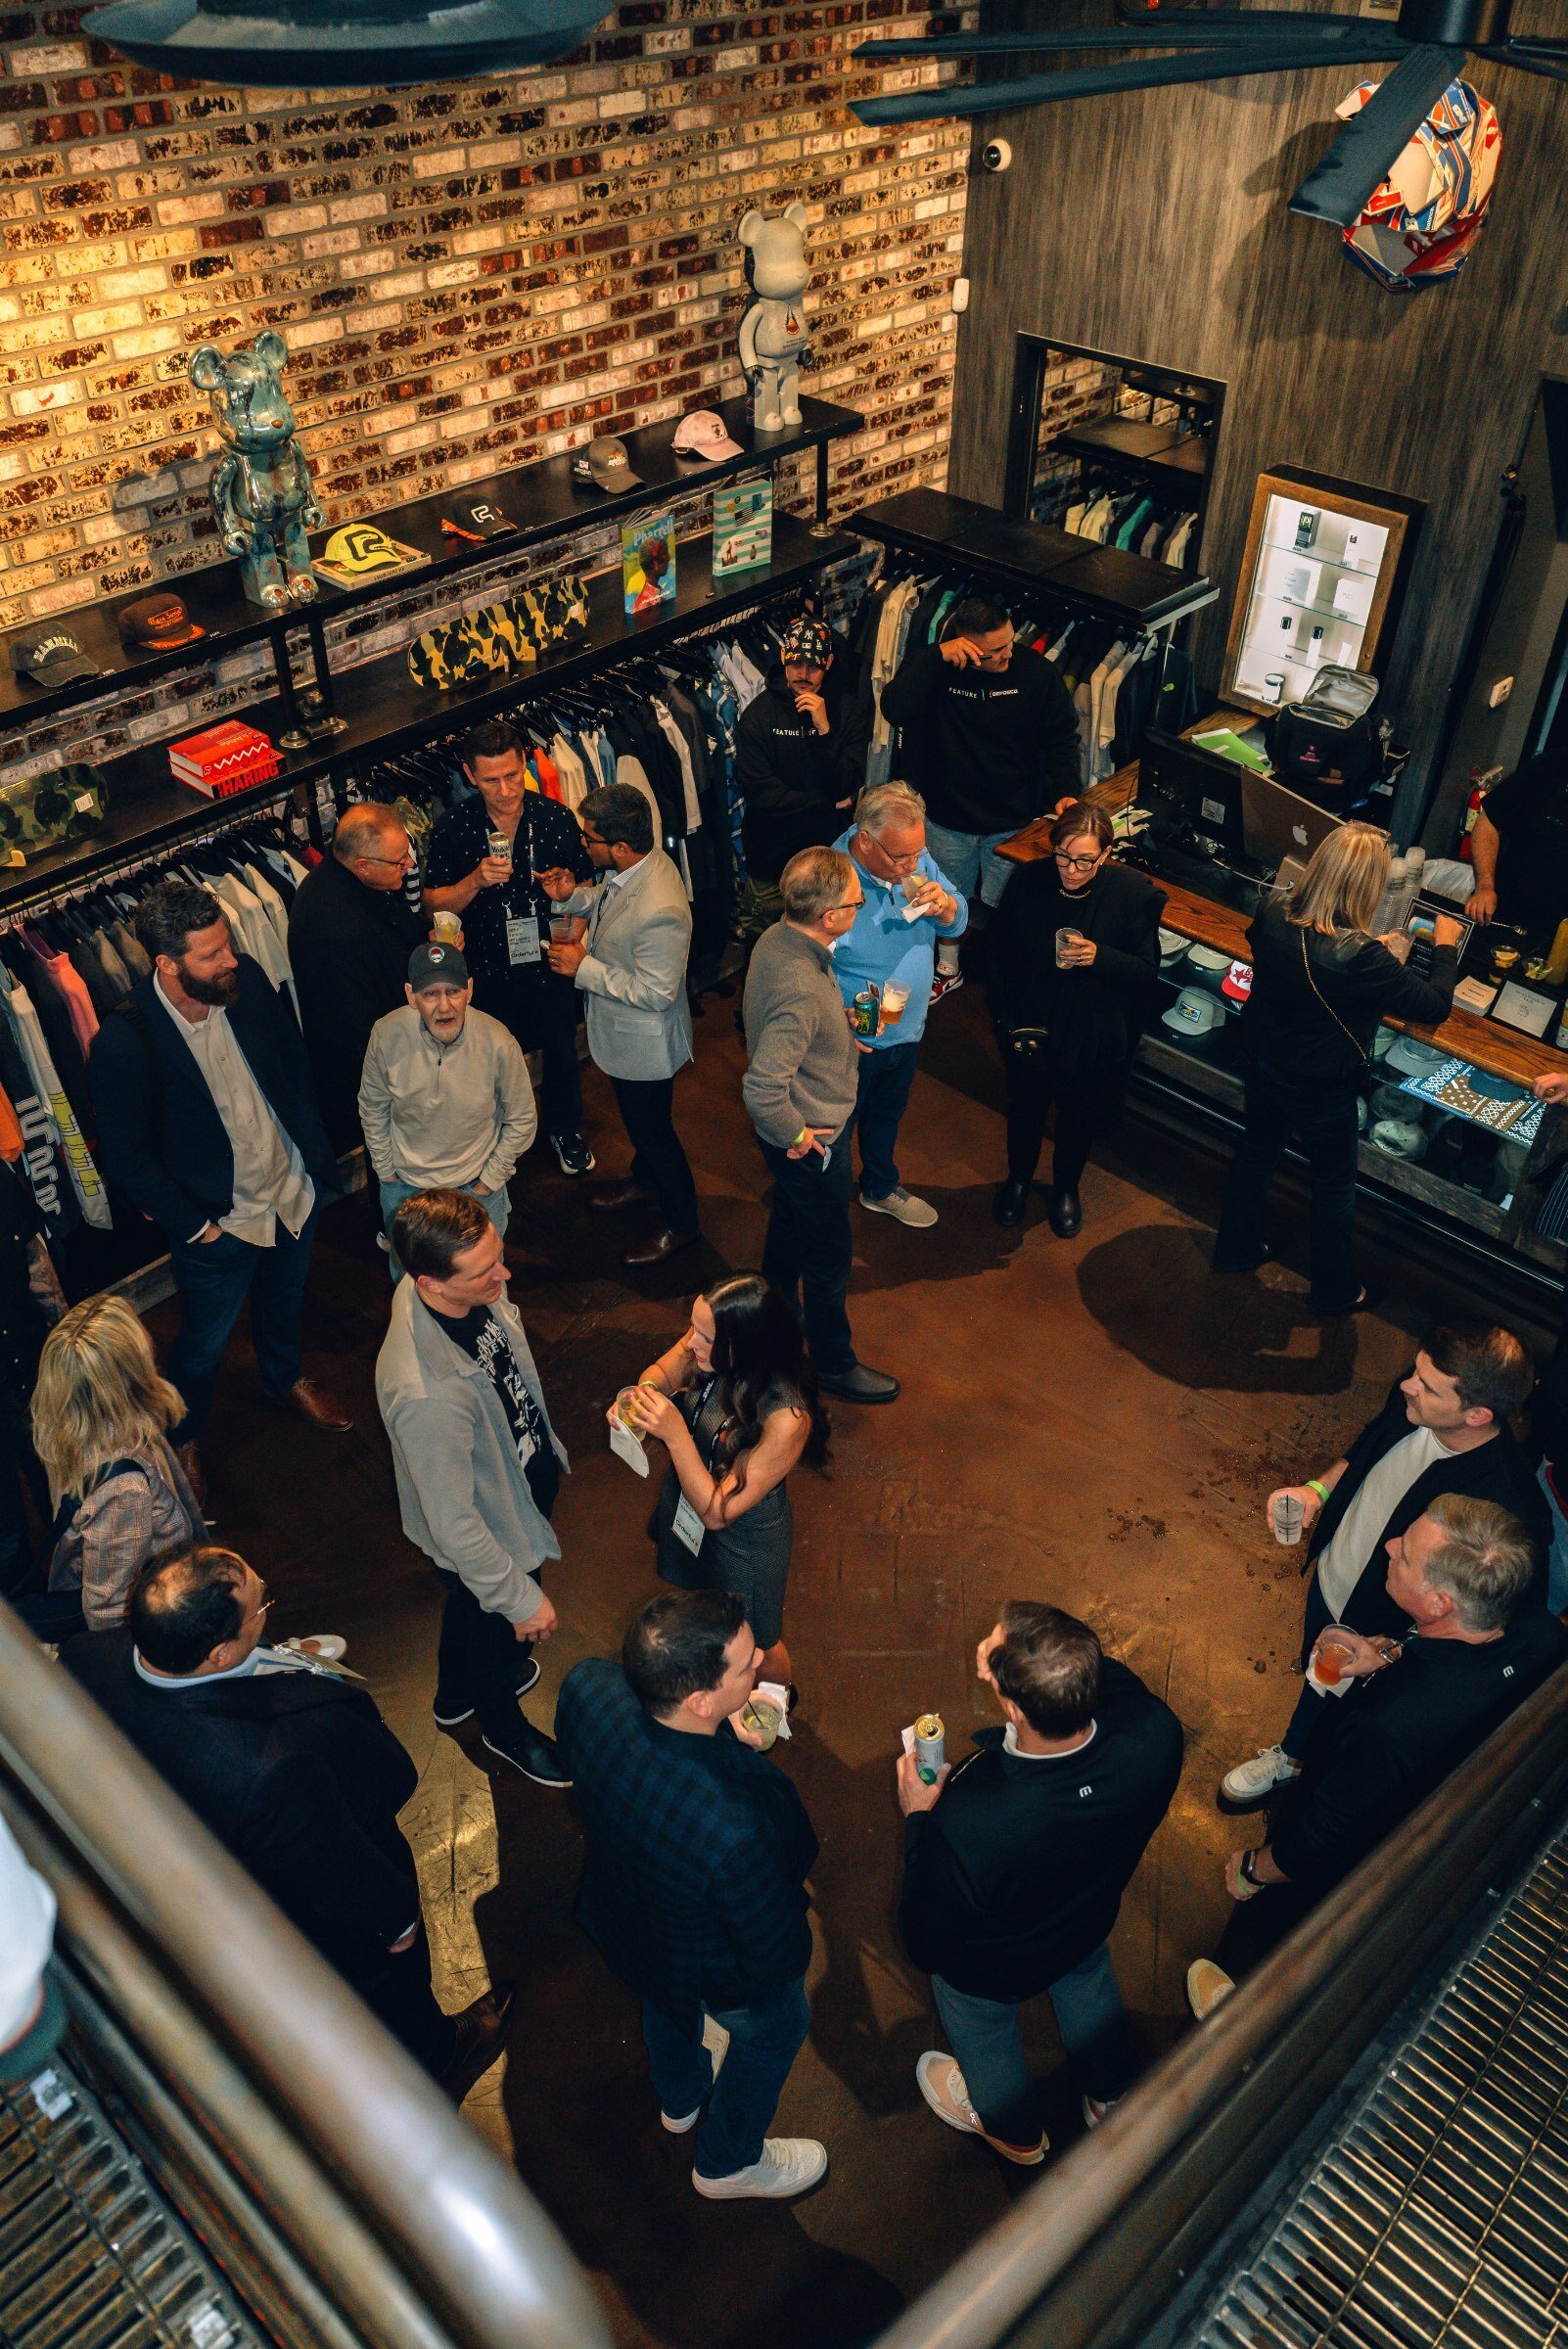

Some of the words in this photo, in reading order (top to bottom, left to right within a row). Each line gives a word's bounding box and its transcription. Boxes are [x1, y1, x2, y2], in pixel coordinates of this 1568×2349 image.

[633, 518, 674, 546] Pharrell
[948, 686, 978, 699] FEATURE
[222, 761, 280, 797] HARING
